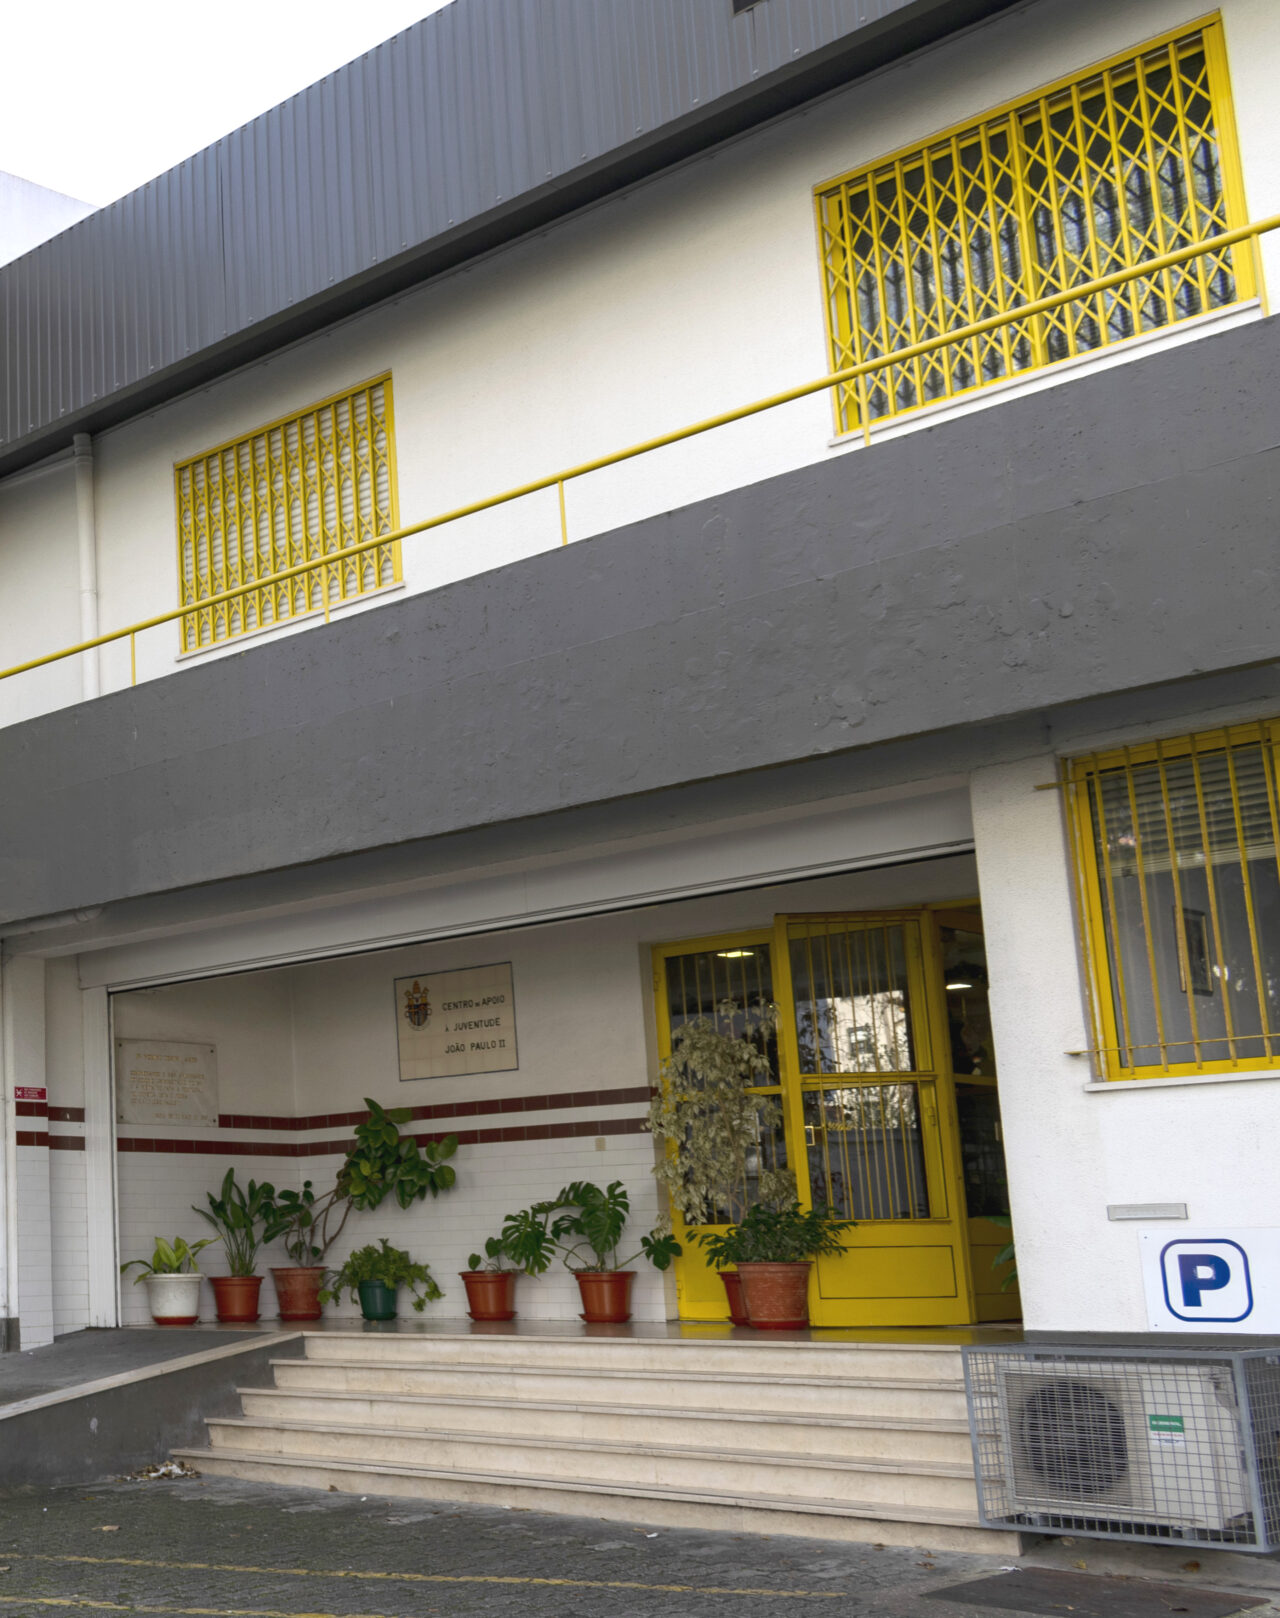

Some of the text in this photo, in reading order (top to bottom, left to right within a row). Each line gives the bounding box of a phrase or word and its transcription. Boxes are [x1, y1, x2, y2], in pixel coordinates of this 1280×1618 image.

[442, 1000, 473, 1011] CENTRO
[481, 995, 505, 1006] APOIO
[453, 1017, 501, 1032] JUVENTUDE
[445, 1039, 506, 1054] JOÃO PAULO II
[1177, 1253, 1231, 1308] P
